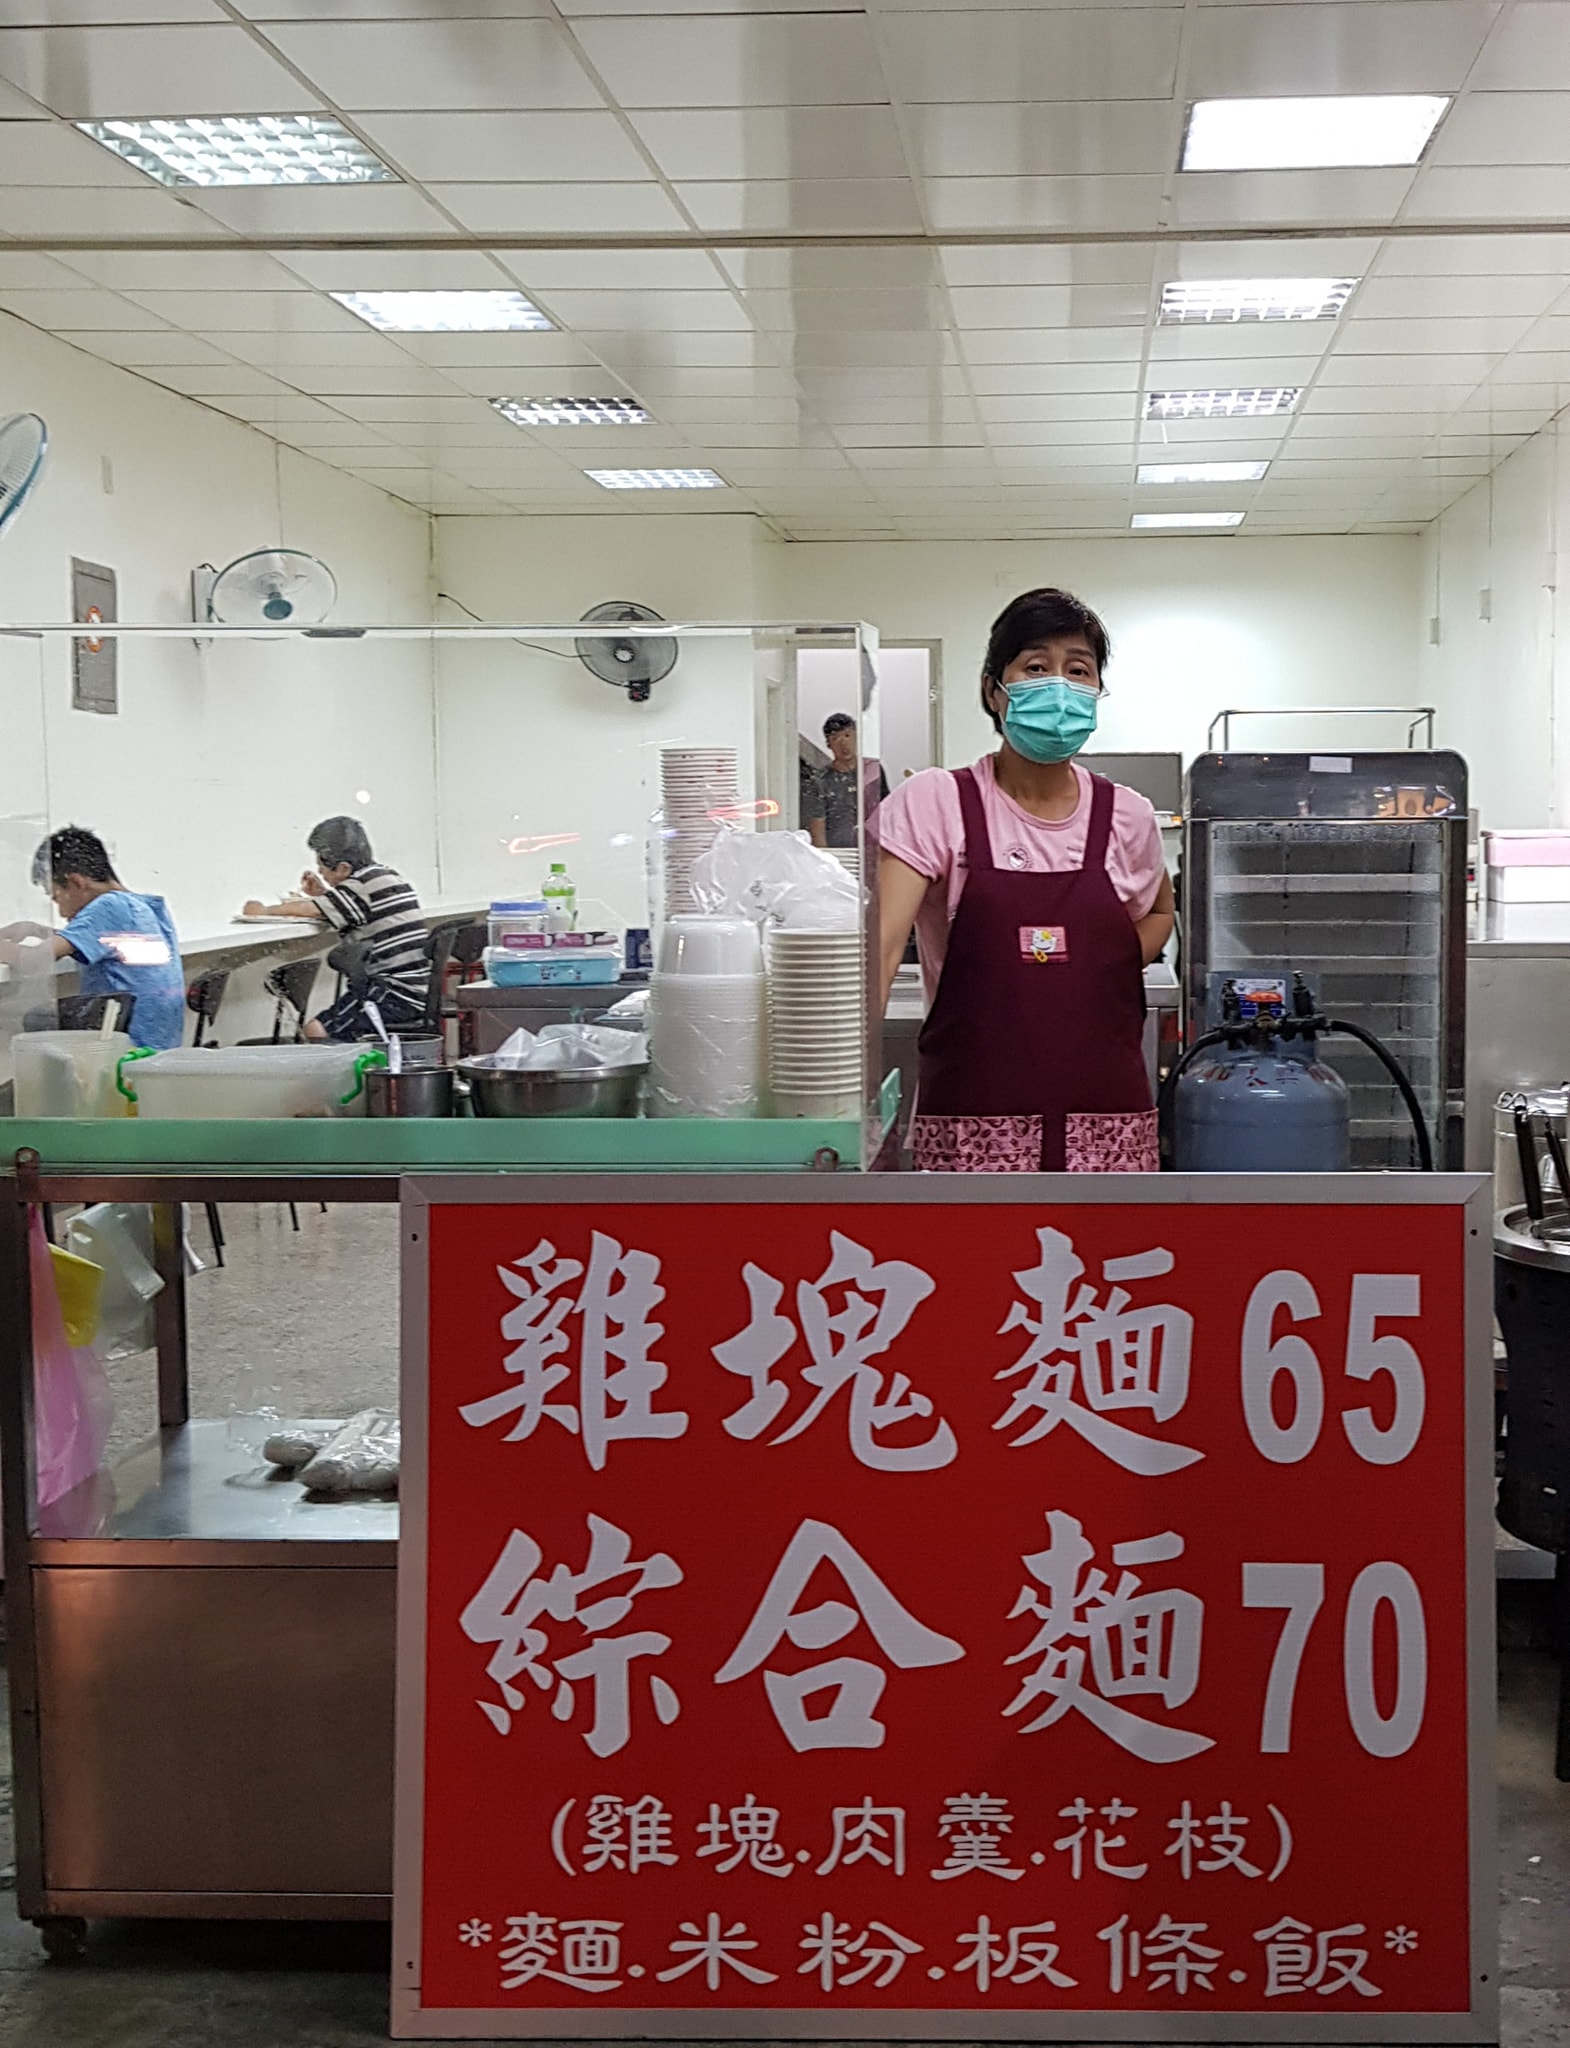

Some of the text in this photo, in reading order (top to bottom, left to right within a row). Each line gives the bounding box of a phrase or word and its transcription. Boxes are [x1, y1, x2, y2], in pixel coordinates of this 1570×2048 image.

[458, 1227, 1426, 1476] 雞塊麵 65
[459, 1510, 1427, 1764] 綜合麵 70
